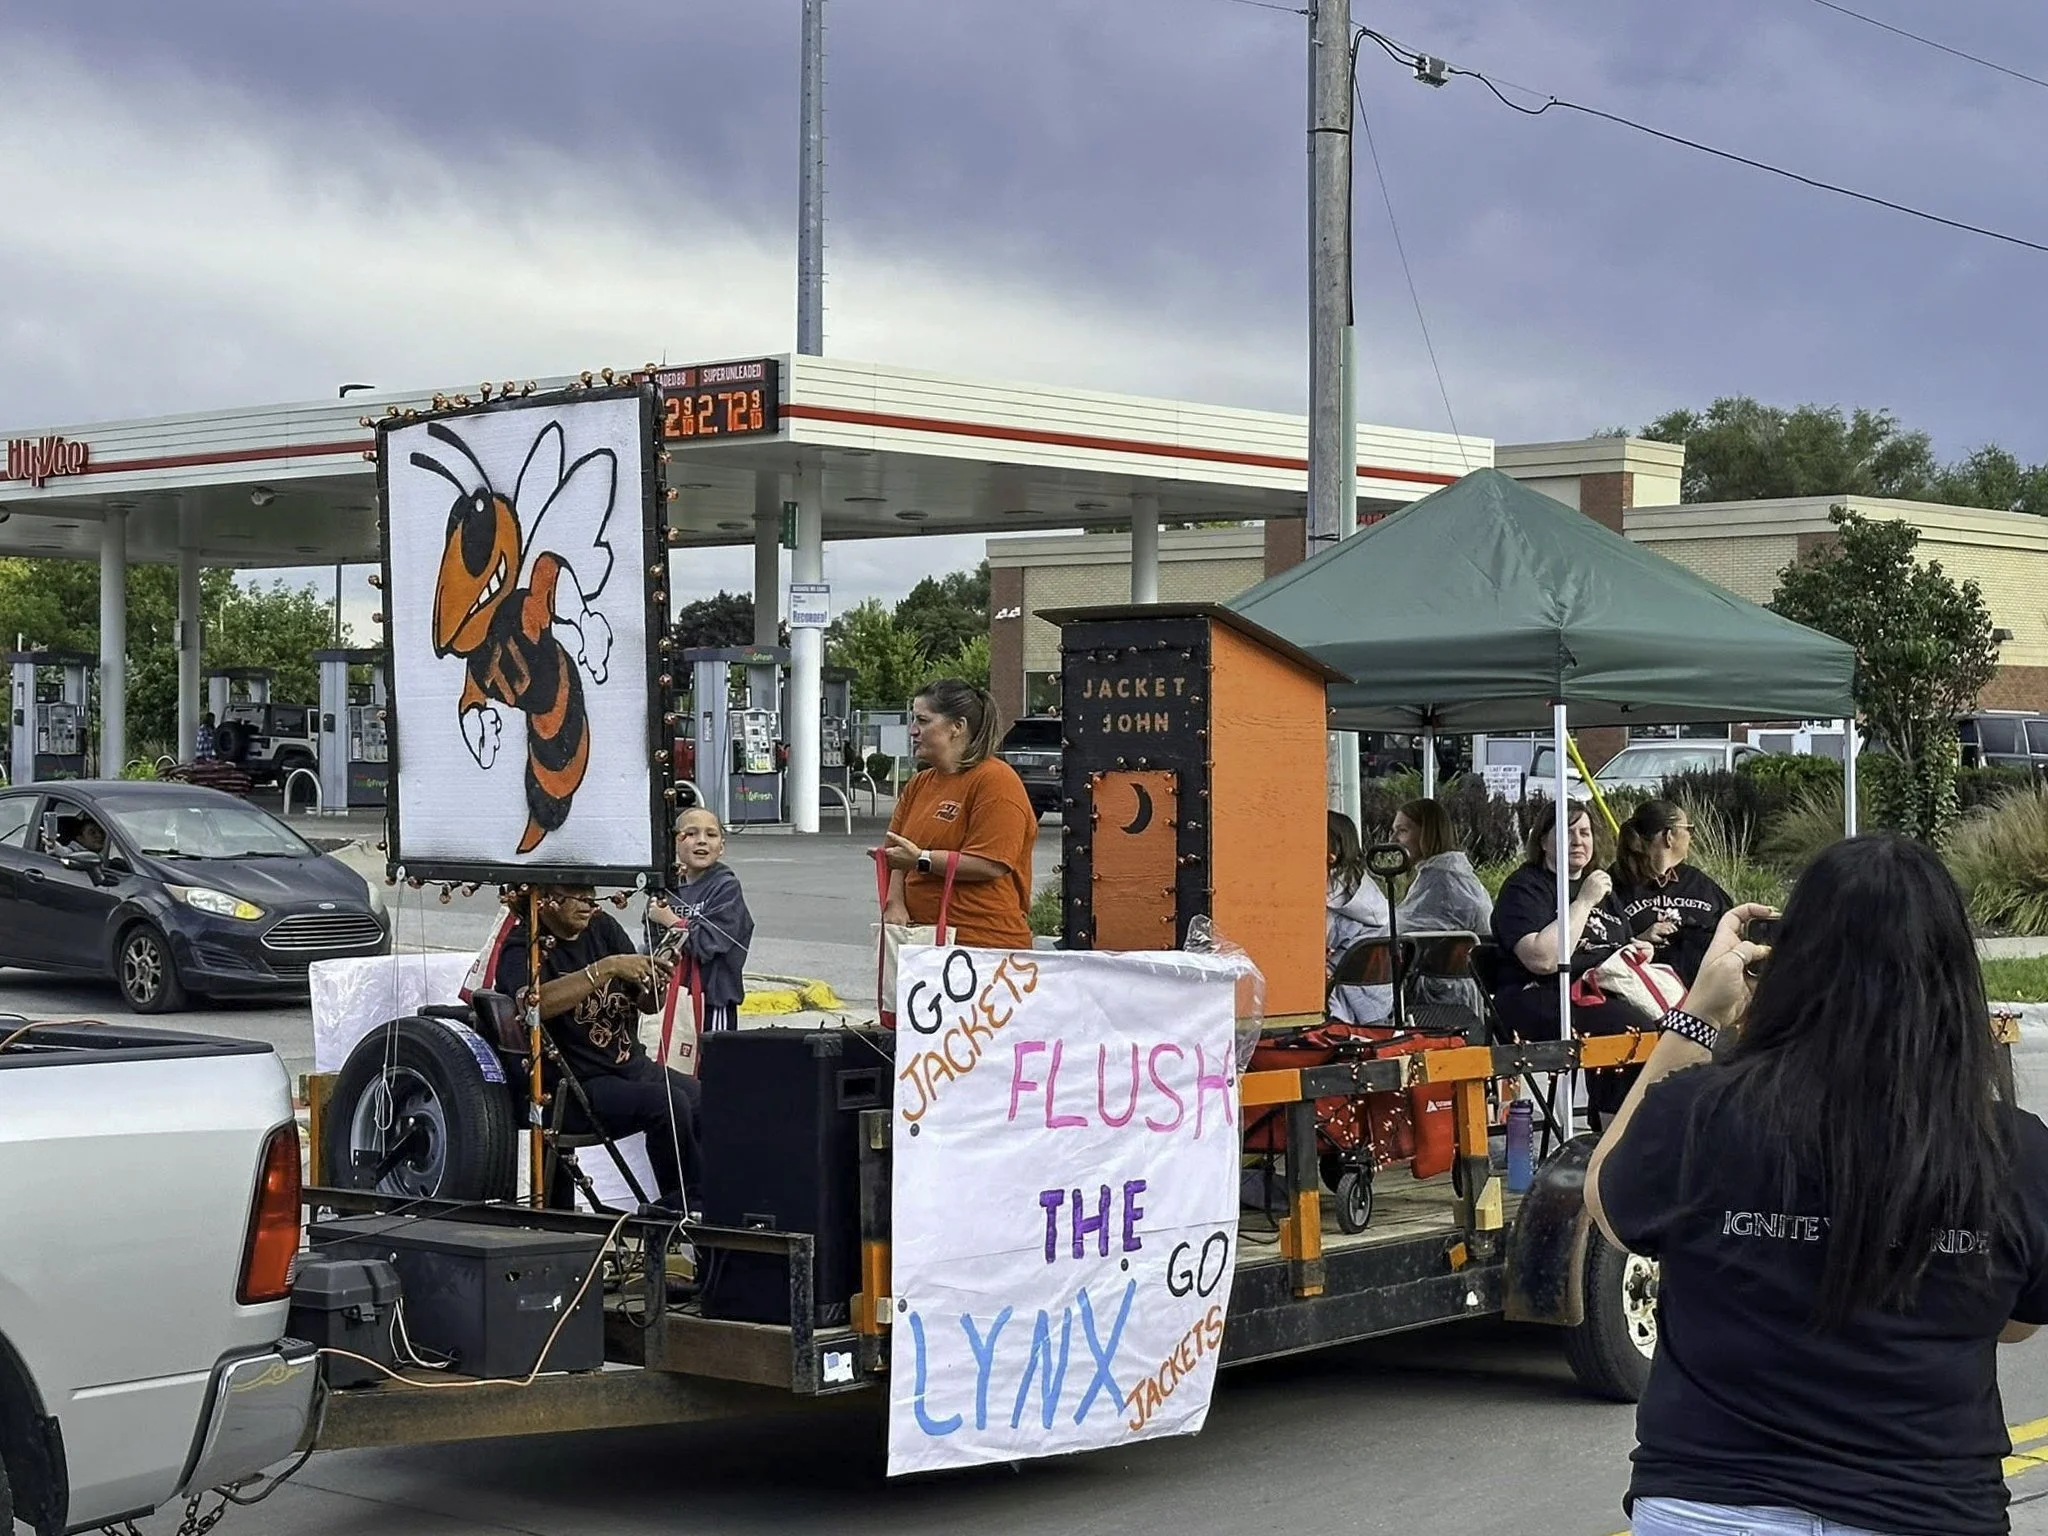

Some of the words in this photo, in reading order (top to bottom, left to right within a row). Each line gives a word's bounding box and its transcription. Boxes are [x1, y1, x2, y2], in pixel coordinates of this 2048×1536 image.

[1083, 677, 1185, 699] JACKET
[1102, 711, 1169, 733] JOHN
[1624, 895, 1661, 918] ELLOW
[1662, 894, 1712, 912] JACKETS
[907, 949, 977, 1034] GO
[899, 952, 1039, 1122] JACKETS
[1008, 1038, 1233, 1140] FLUSH
[1039, 1179, 1147, 1264] THE
[1166, 1230, 1229, 1298] GO
[1722, 1210, 1819, 1241] IGNITE
[908, 1278, 1137, 1436] LYNX
[1124, 1304, 1223, 1431] JACKETS
